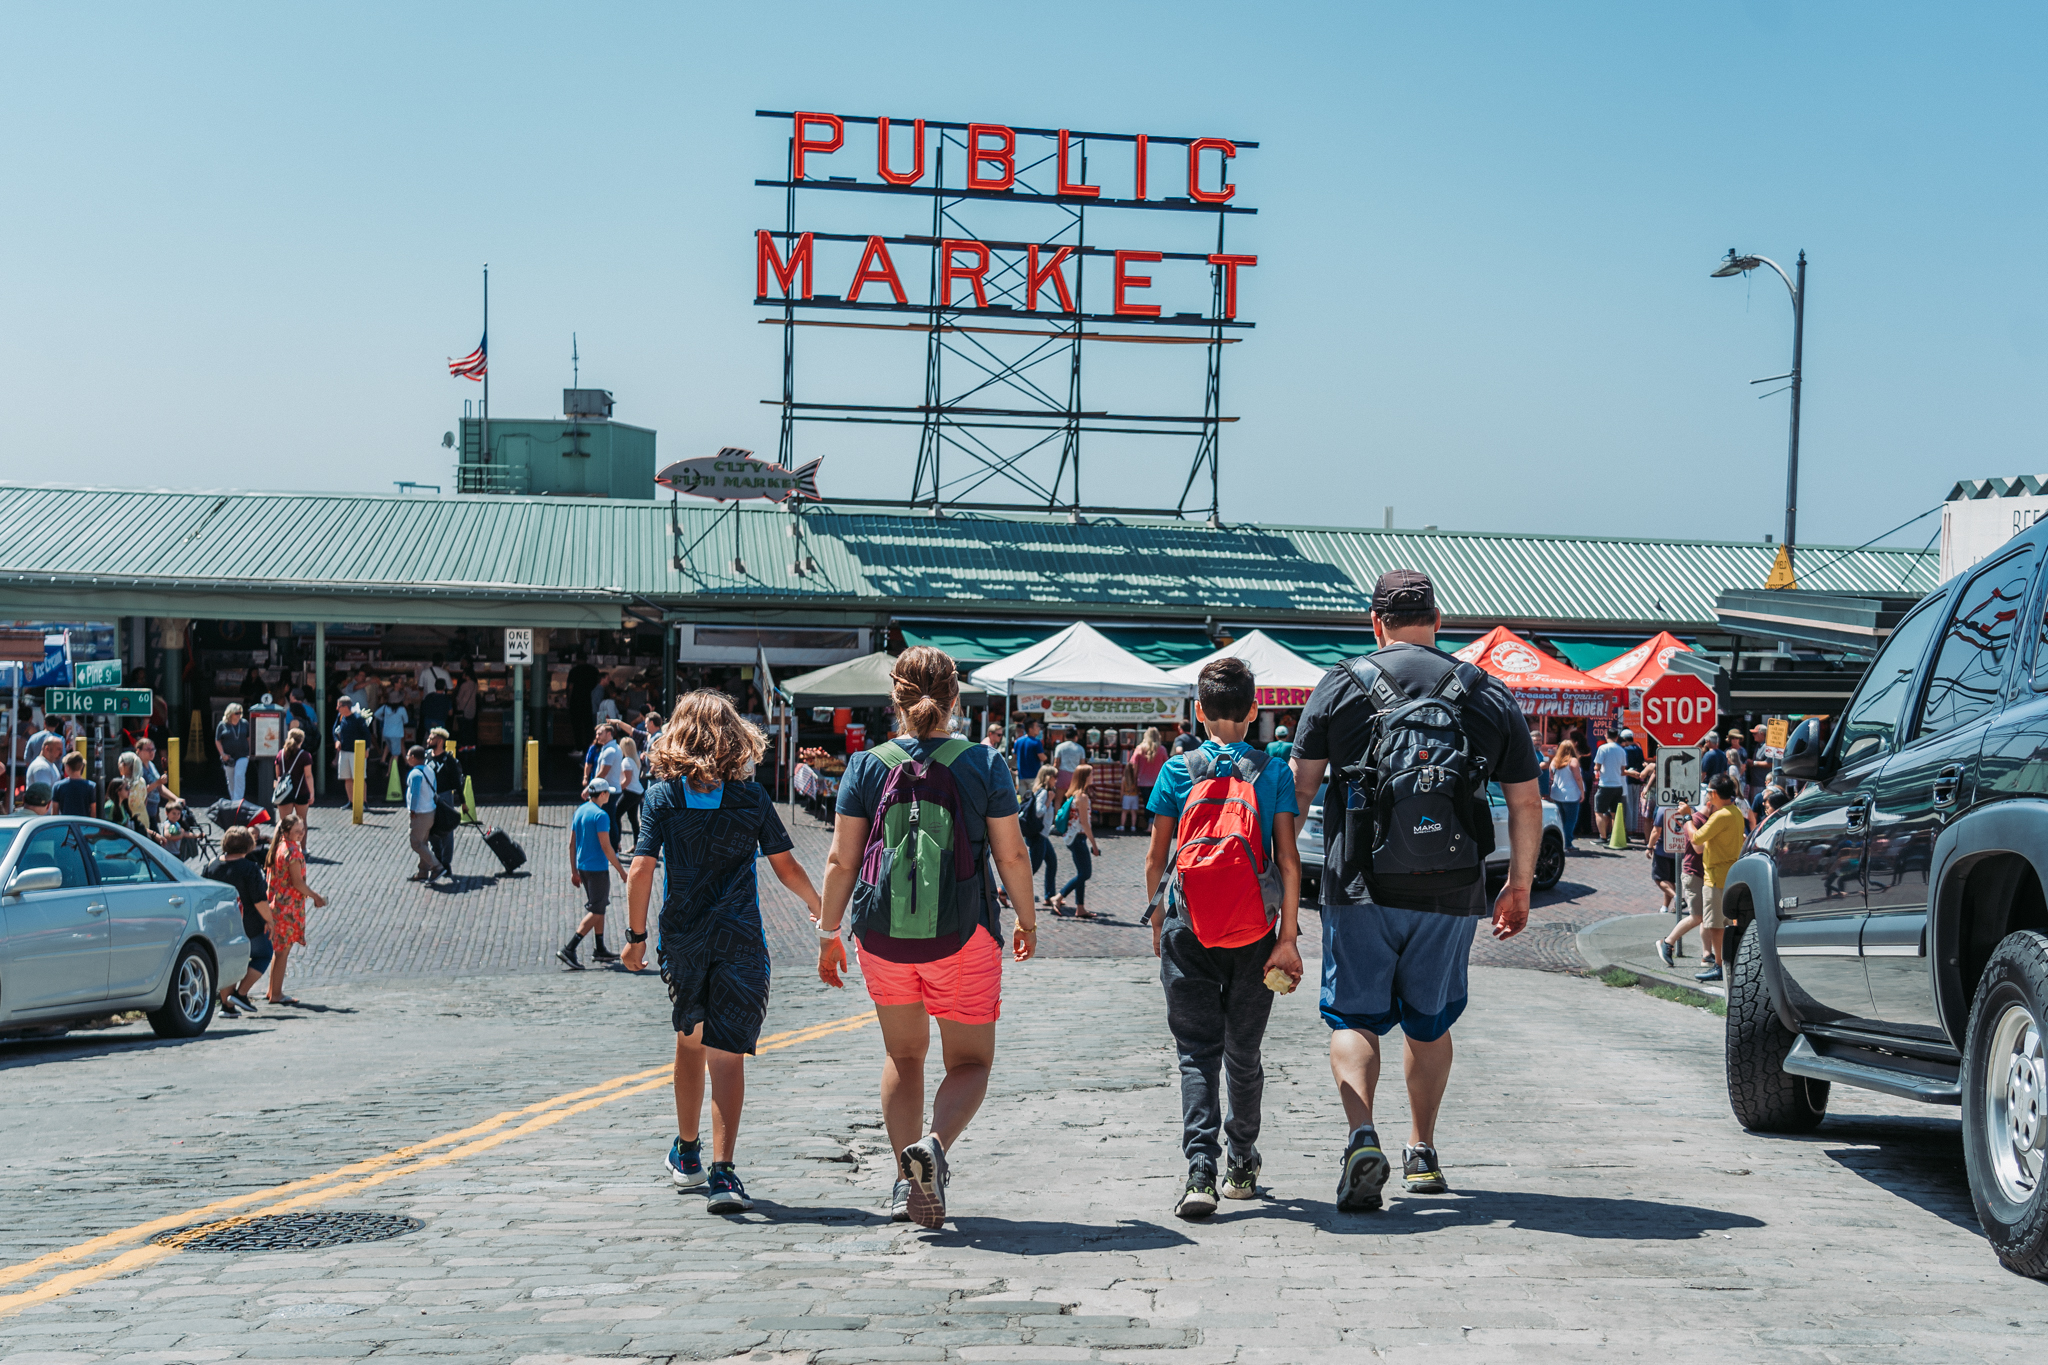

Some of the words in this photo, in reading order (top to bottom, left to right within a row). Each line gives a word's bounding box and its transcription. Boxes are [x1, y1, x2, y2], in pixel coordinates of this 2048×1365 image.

[794, 111, 1236, 203] PUBLIC
[756, 229, 1257, 319] MARKET
[714, 460, 764, 473] CITY
[672, 475, 715, 487] FISH
[723, 476, 801, 489] MARKET
[509, 631, 529, 640] ONE
[509, 641, 529, 650] WAY
[86, 665, 103, 685] Pine
[105, 669, 112, 683] St
[1525, 673, 1585, 686] Famous
[53, 691, 93, 711] Pike
[104, 698, 117, 711] Pl
[138, 693, 150, 703] 60
[1515, 690, 1557, 699] Pressed
[1562, 691, 1605, 700] Organic
[1052, 700, 1155, 714] SLUSHIES
[1537, 699, 1570, 715] APPLE
[1572, 700, 1609, 717] CIDER!
[1646, 697, 1712, 725] STOP
[1592, 720, 1612, 729] APPLE
[1413, 822, 1441, 833] MAKO
